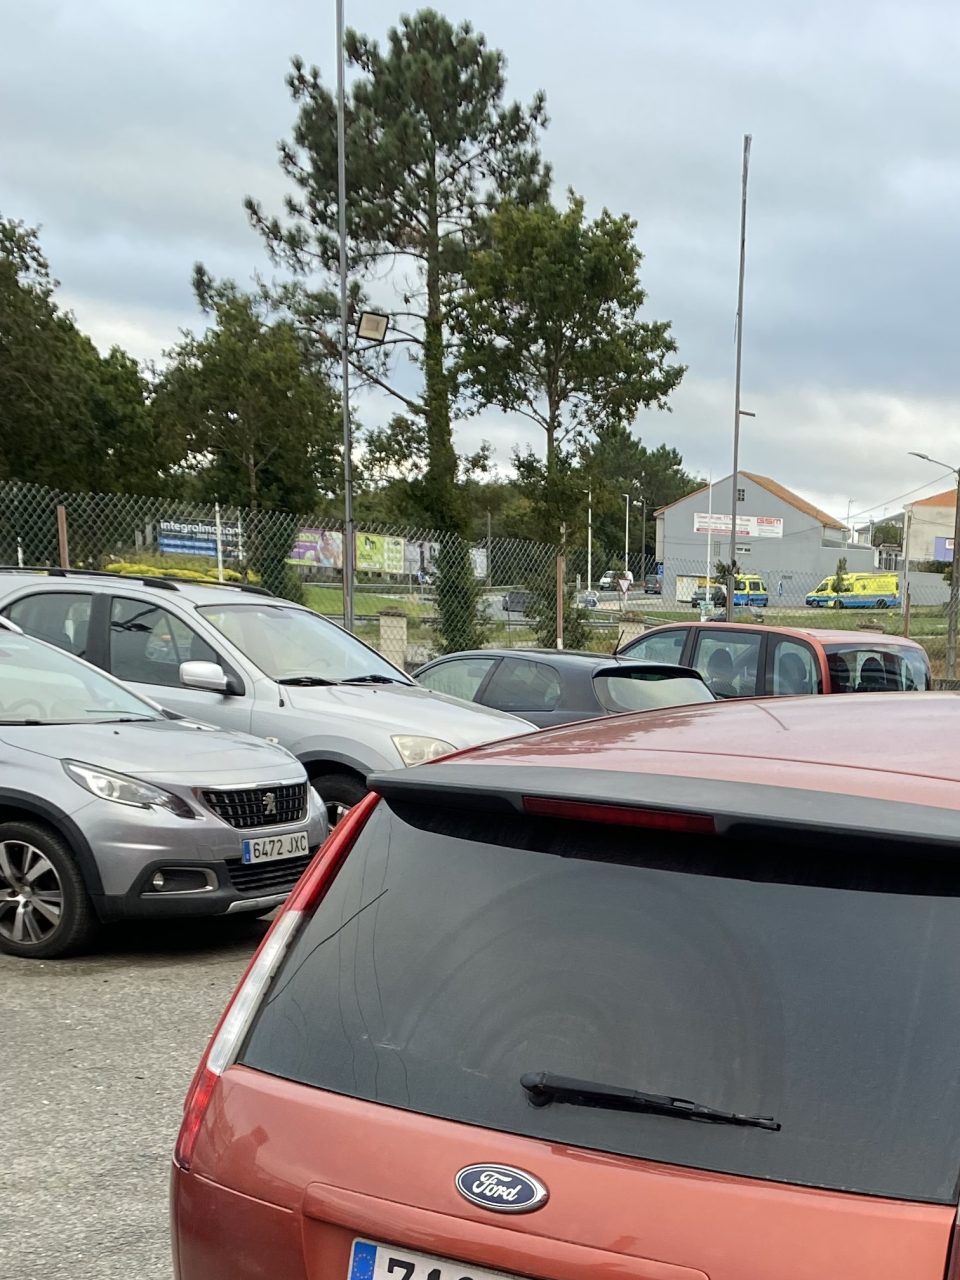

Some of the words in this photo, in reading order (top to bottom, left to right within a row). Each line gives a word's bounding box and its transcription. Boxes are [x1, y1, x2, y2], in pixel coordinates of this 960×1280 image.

[253, 839, 283, 858] 6472
[287, 835, 306, 854] JXC
[472, 1171, 522, 1201] Ford
